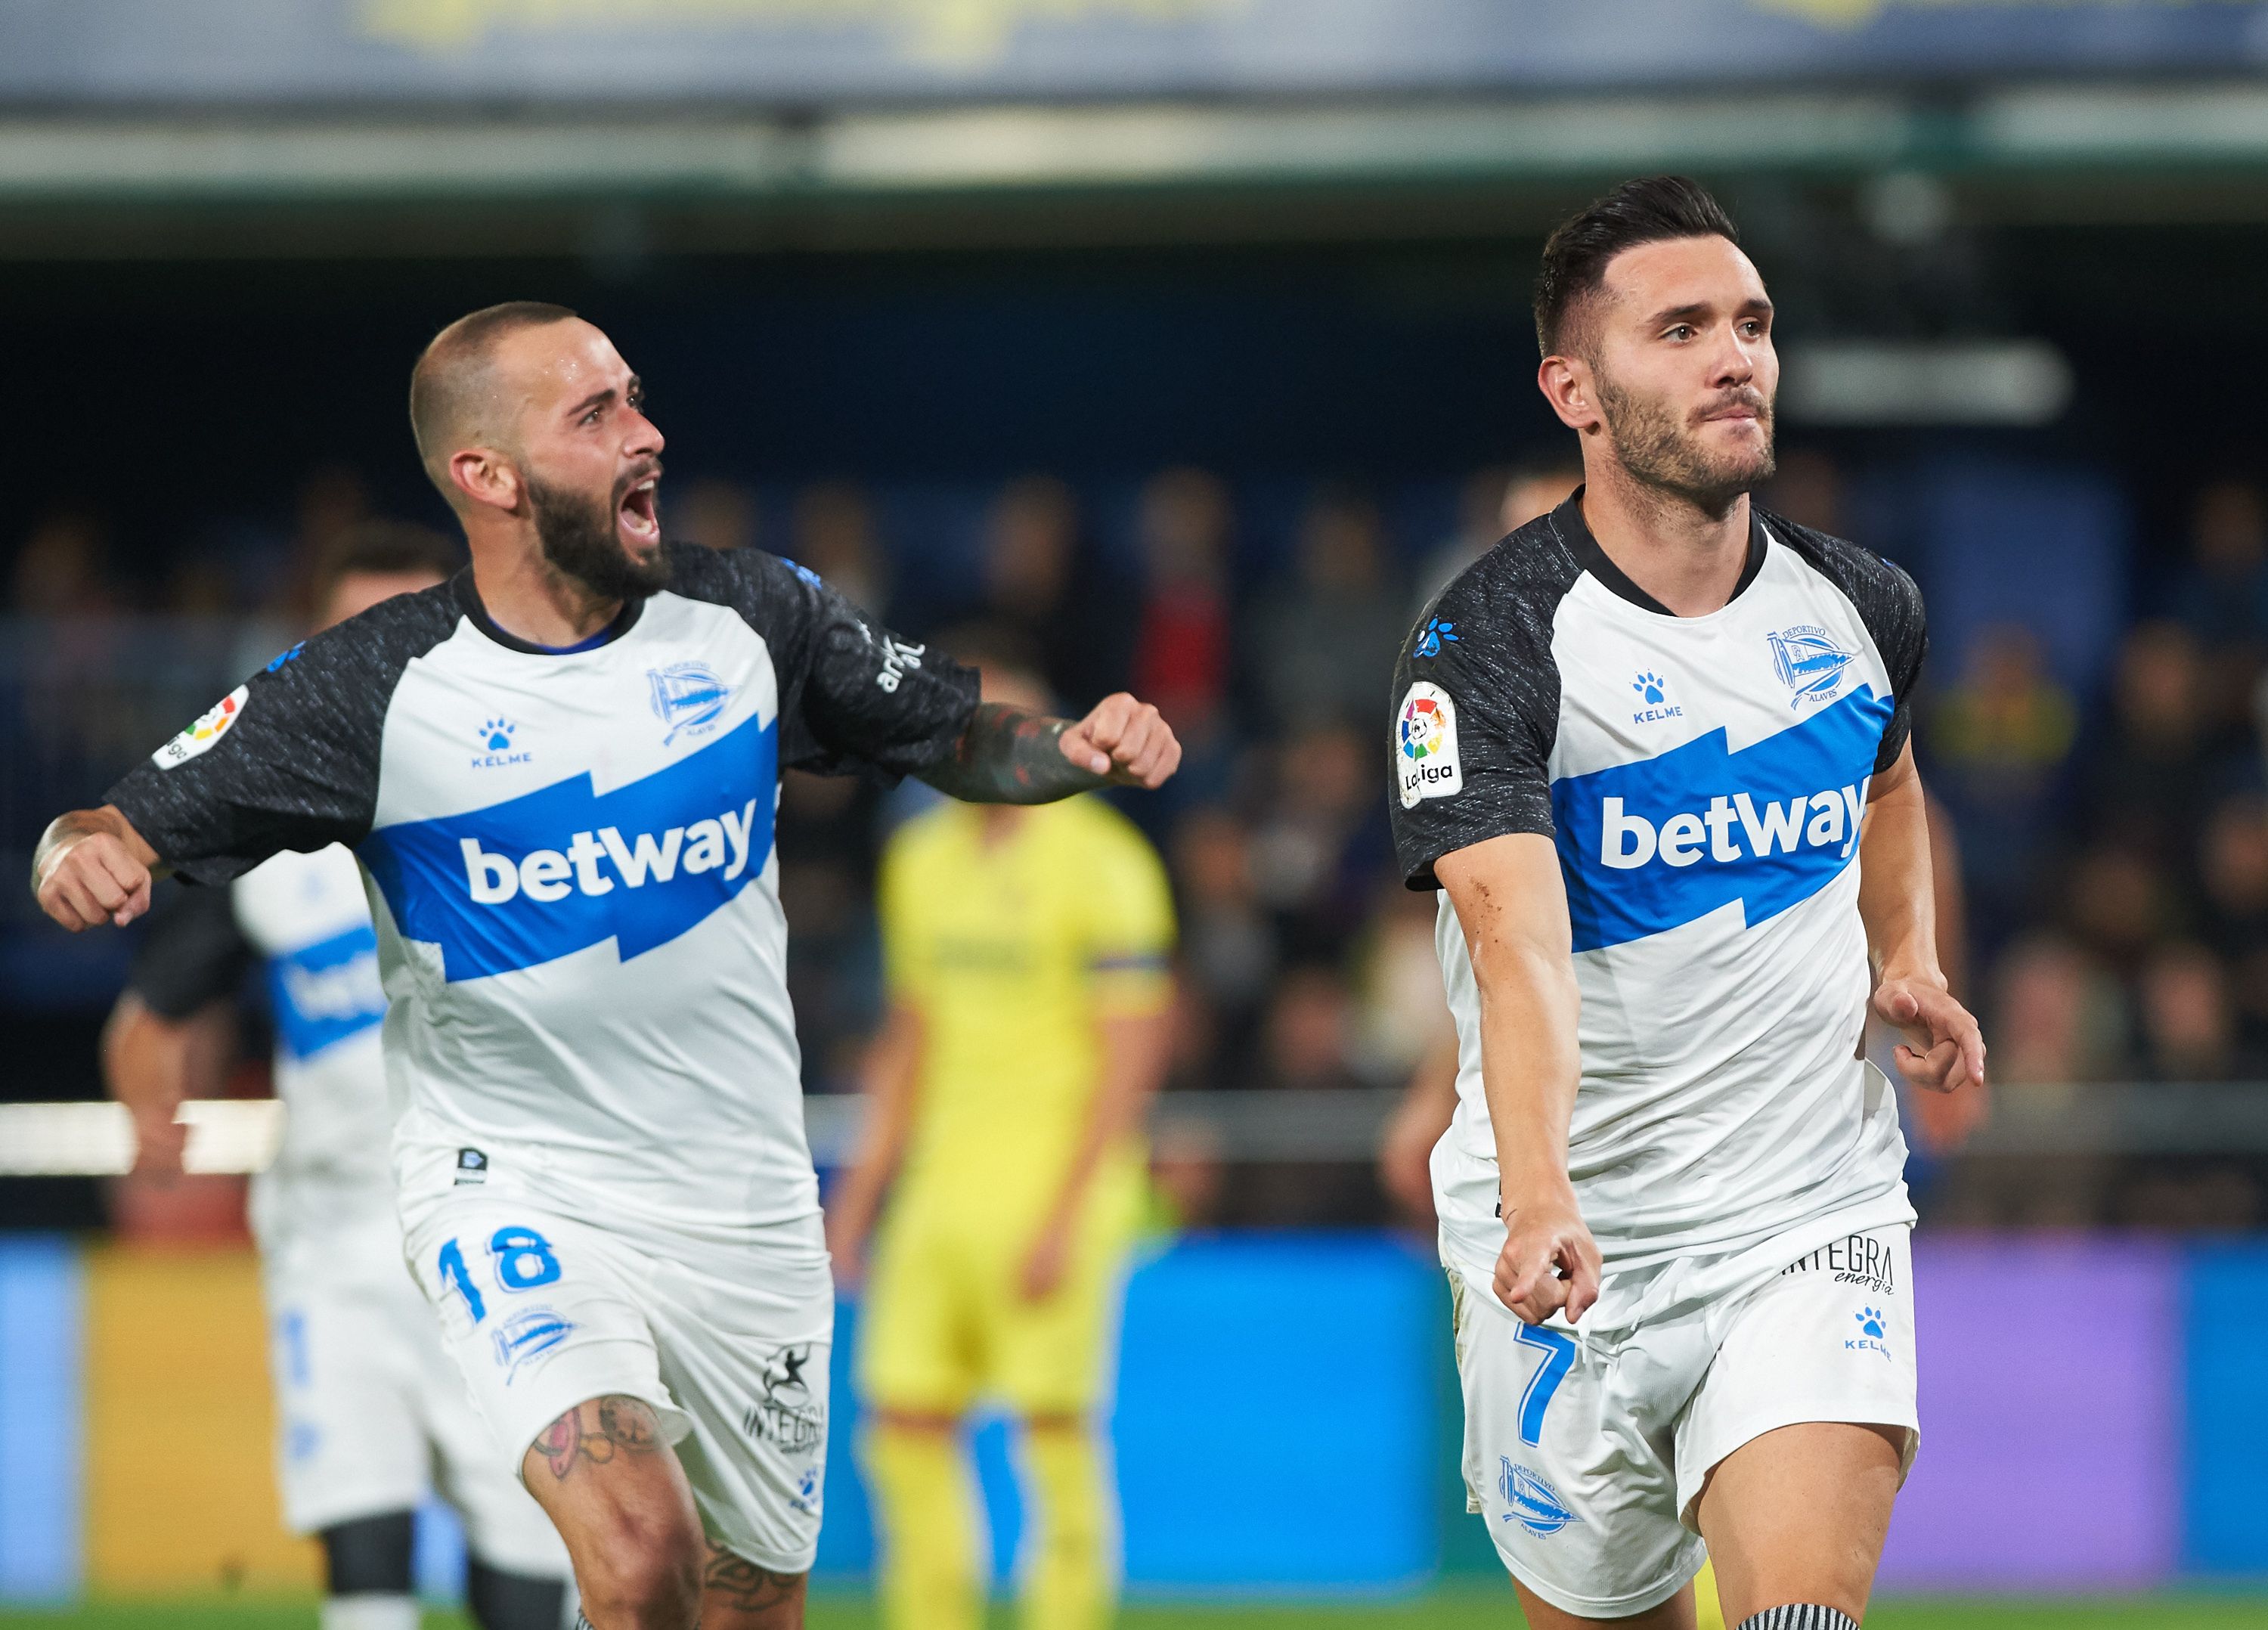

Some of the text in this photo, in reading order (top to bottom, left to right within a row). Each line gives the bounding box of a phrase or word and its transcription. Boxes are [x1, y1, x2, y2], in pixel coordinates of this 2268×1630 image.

[1782, 624, 1826, 640] DEPORTIVO
[1633, 706, 1683, 724] KELME
[471, 752, 532, 769] KELME
[1405, 764, 1453, 792] Laiga
[460, 798, 757, 905] betway
[1600, 774, 1871, 869] betway
[438, 1225, 562, 1329] 18
[1513, 1321, 1576, 1448] 7
